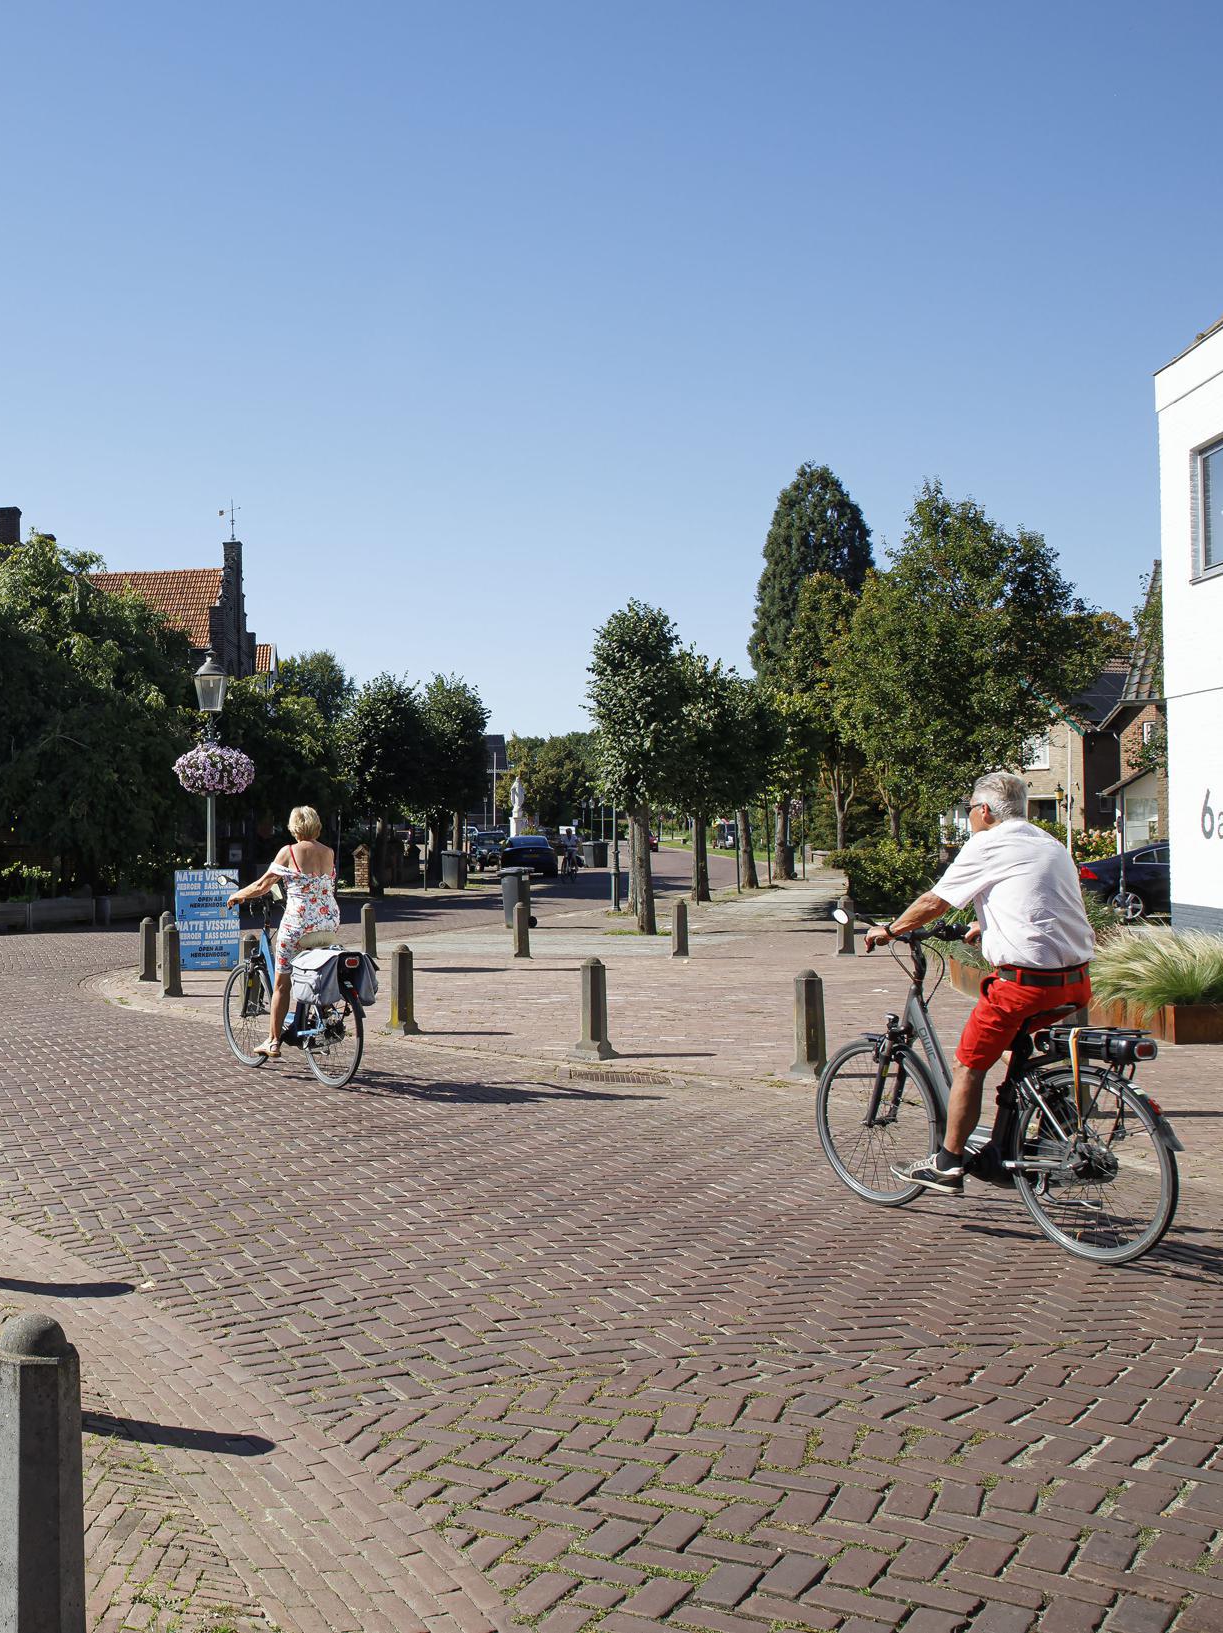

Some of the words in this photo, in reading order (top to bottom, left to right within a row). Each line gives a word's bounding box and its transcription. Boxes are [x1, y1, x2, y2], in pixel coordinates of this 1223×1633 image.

[176, 871, 203, 882] NATTE
[177, 920, 203, 931] NATTE
[205, 919, 240, 930] VISSTICK
